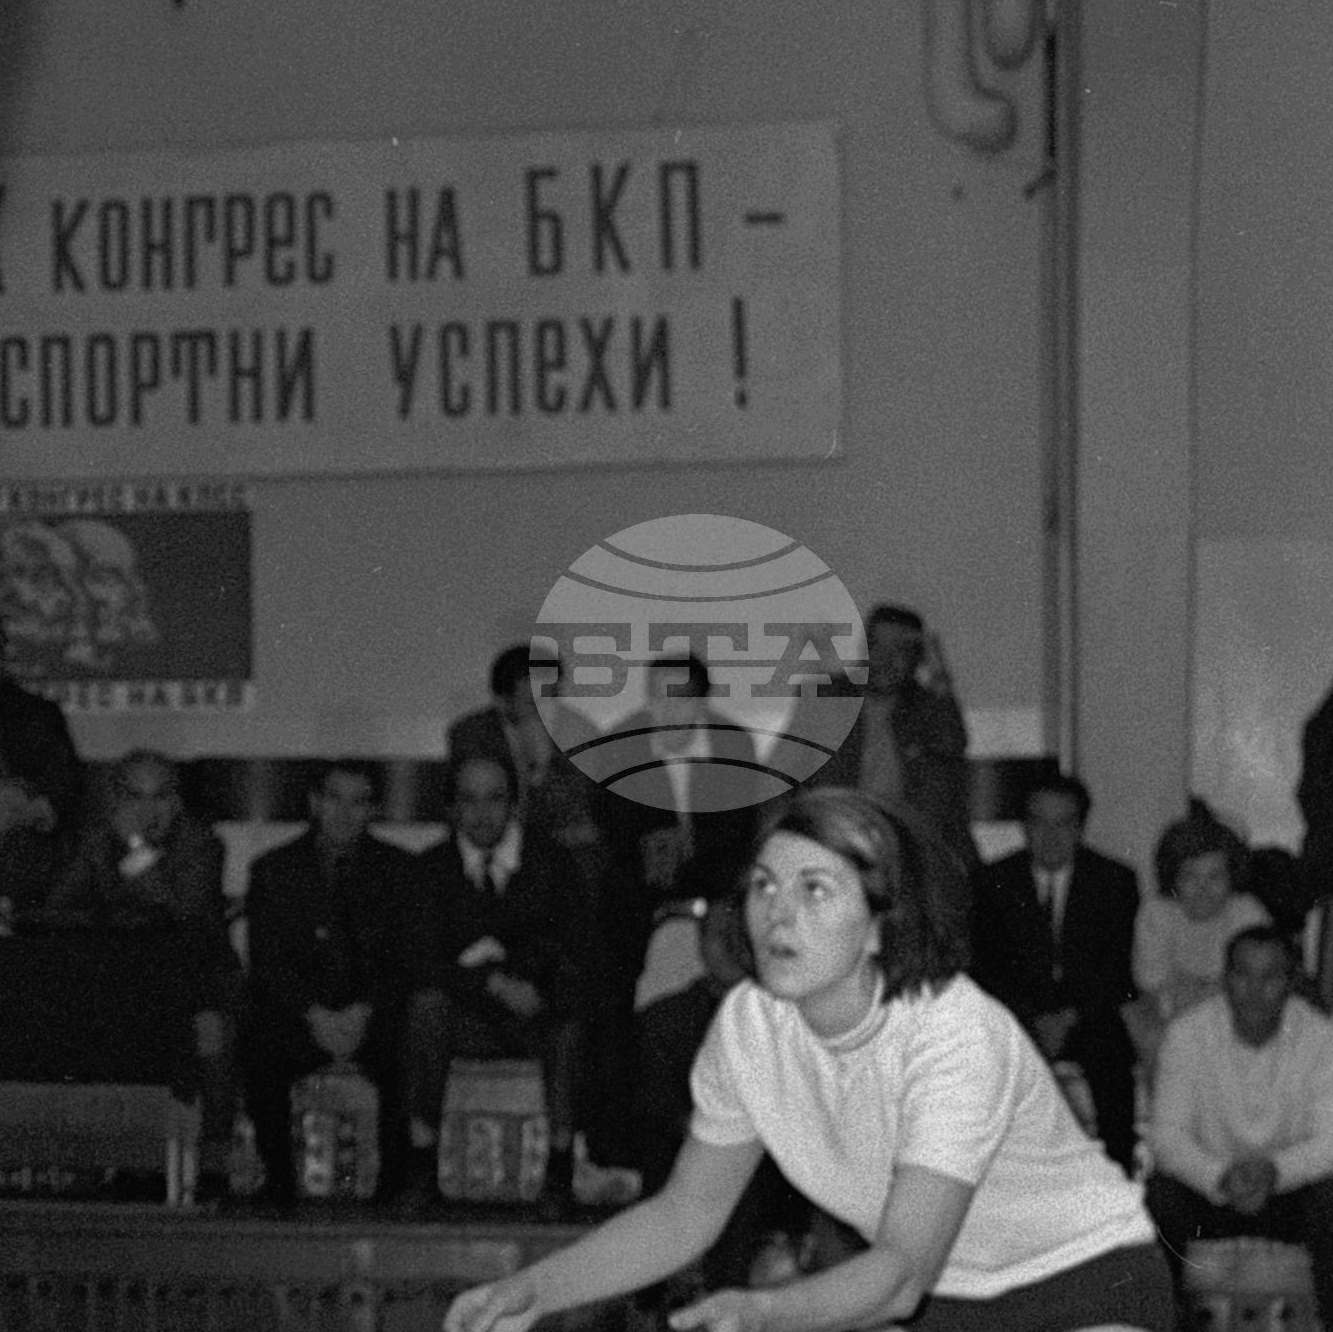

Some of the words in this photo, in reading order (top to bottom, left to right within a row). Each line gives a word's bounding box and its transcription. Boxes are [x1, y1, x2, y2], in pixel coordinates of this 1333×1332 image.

[51, 190, 333, 295] КОНГРЕС
[385, 184, 464, 283] НА
[526, 161, 702, 277] БКП
[389, 314, 672, 421] УСПЕХИ
